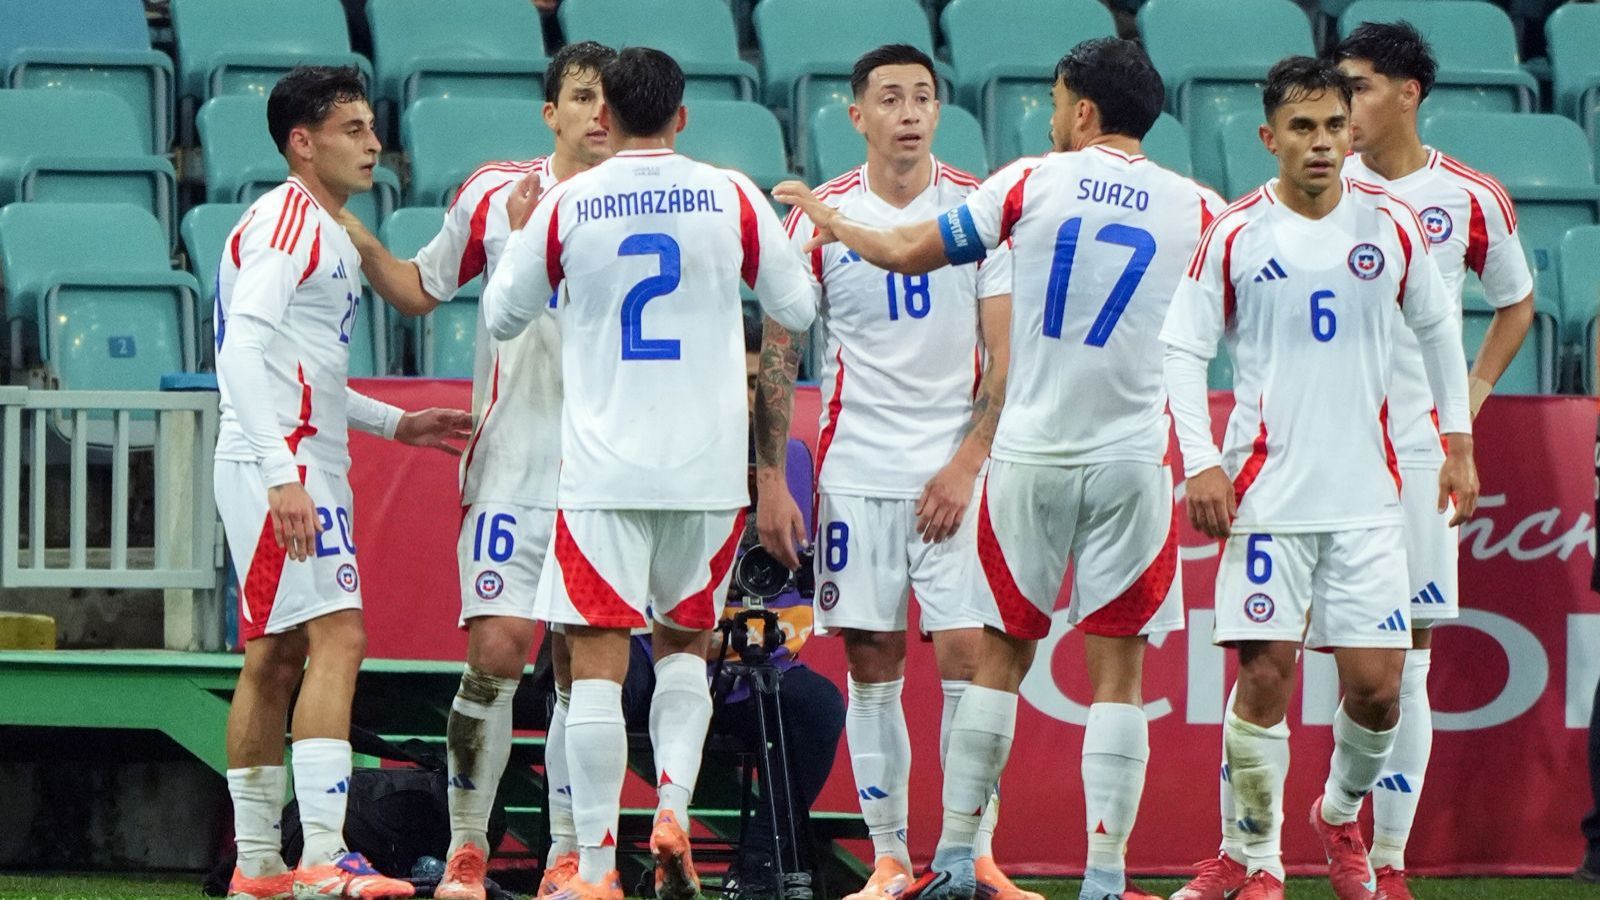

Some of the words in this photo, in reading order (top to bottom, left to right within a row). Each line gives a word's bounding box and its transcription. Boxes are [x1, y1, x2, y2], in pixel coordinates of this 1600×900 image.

[576, 183, 724, 224] HORMAZÁBAL
[1077, 178, 1150, 212] SUAZO
[617, 232, 681, 361] 2
[886, 271, 931, 321] 18
[1042, 211, 1157, 347] 17
[1310, 289, 1338, 342] 6
[117, 338, 129, 355] 2
[315, 506, 356, 558] 20
[473, 511, 517, 563] 16
[818, 521, 849, 575] 18
[1246, 533, 1274, 584] 6
